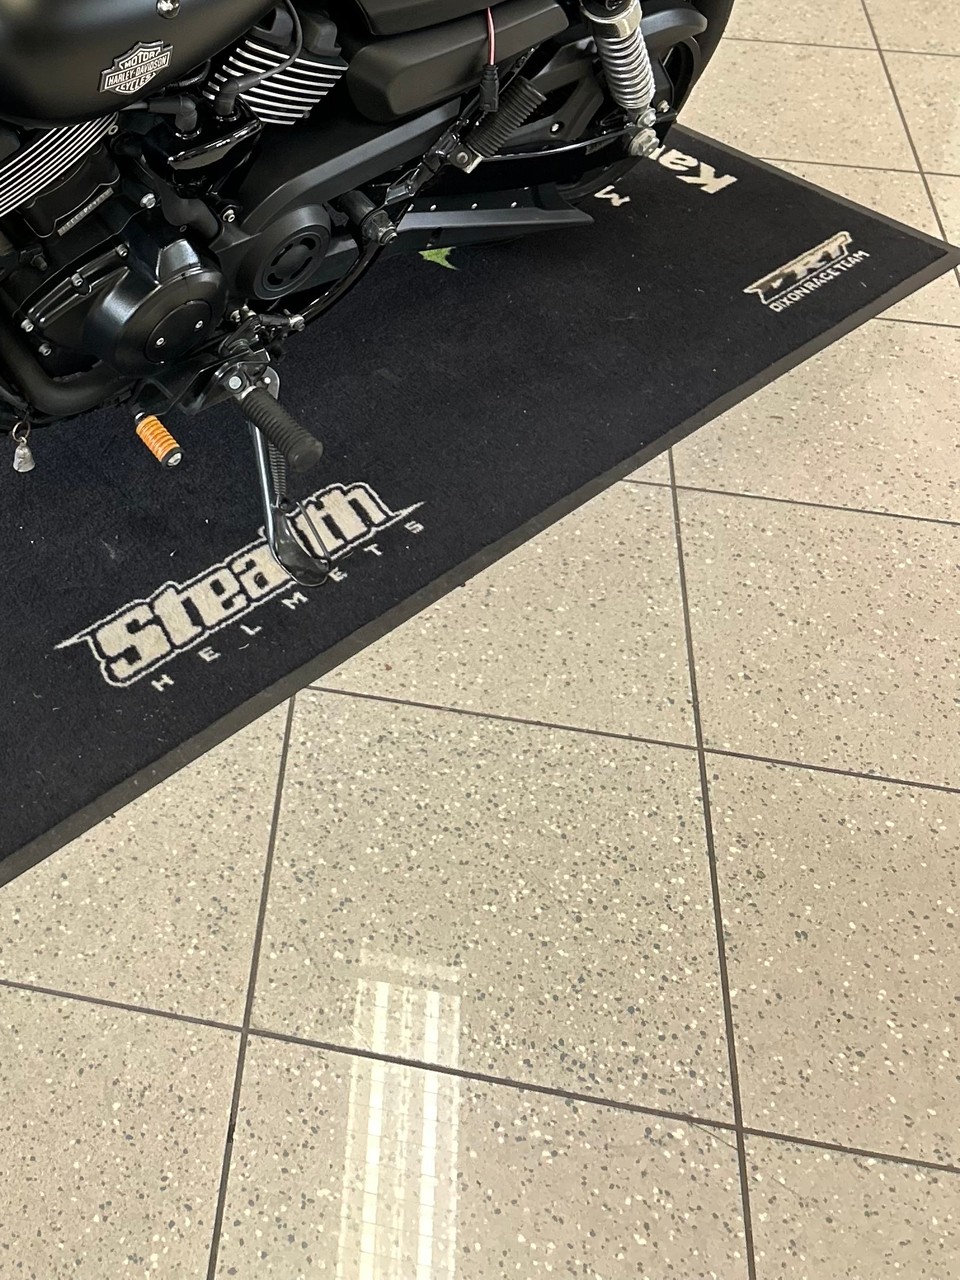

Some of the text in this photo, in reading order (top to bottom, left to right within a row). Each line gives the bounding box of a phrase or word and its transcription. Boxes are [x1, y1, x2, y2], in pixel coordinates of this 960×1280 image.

[108, 55, 167, 86] HARLEY-DAVIDSON
[123, 51, 159, 69] MOTOR
[120, 73, 152, 91] CYCLES
[85, 484, 394, 686] Steath
